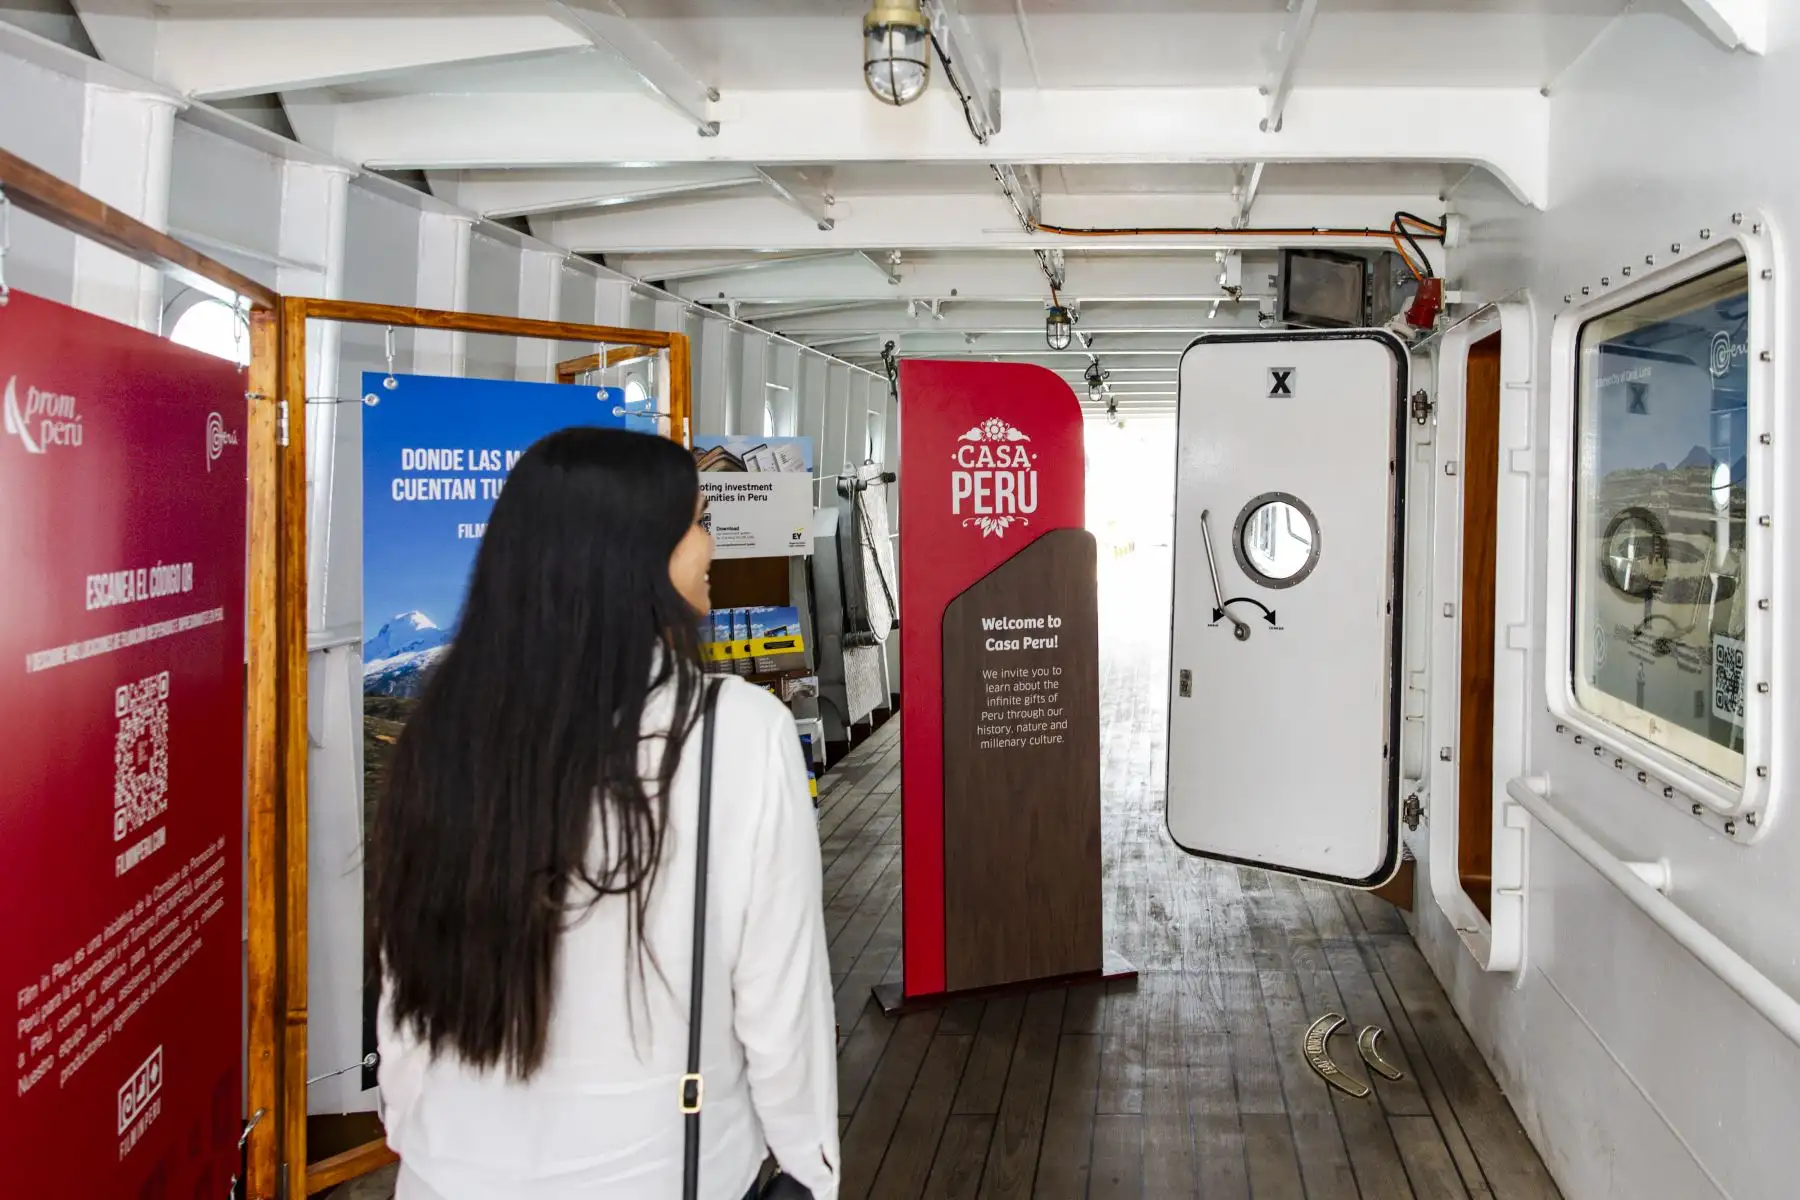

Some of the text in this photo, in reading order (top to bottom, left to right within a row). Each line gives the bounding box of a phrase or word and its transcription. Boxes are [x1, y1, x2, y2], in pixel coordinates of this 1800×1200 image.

[1270, 371, 1291, 394] X
[23, 384, 76, 424] prom
[41, 414, 83, 454] perú
[401, 448, 464, 471] DONDE
[468, 449, 501, 472] LAS
[957, 445, 1032, 468] CASA
[391, 478, 508, 501] CUENTAN TU
[700, 483, 773, 493] oting investment
[951, 467, 1038, 515] PERÚ
[705, 493, 768, 502] unities in Peru
[981, 615, 1062, 631] Welcome to
[985, 635, 1059, 651] Casa Peru!
[982, 666, 1062, 680] We invite you to
[985, 680, 1059, 693] learn about the
[987, 692, 1059, 707] infinite gifts of
[981, 707, 1063, 721] Peru through our
[977, 720, 1068, 736] history, nature and
[980, 733, 1065, 750] millenary culture.
